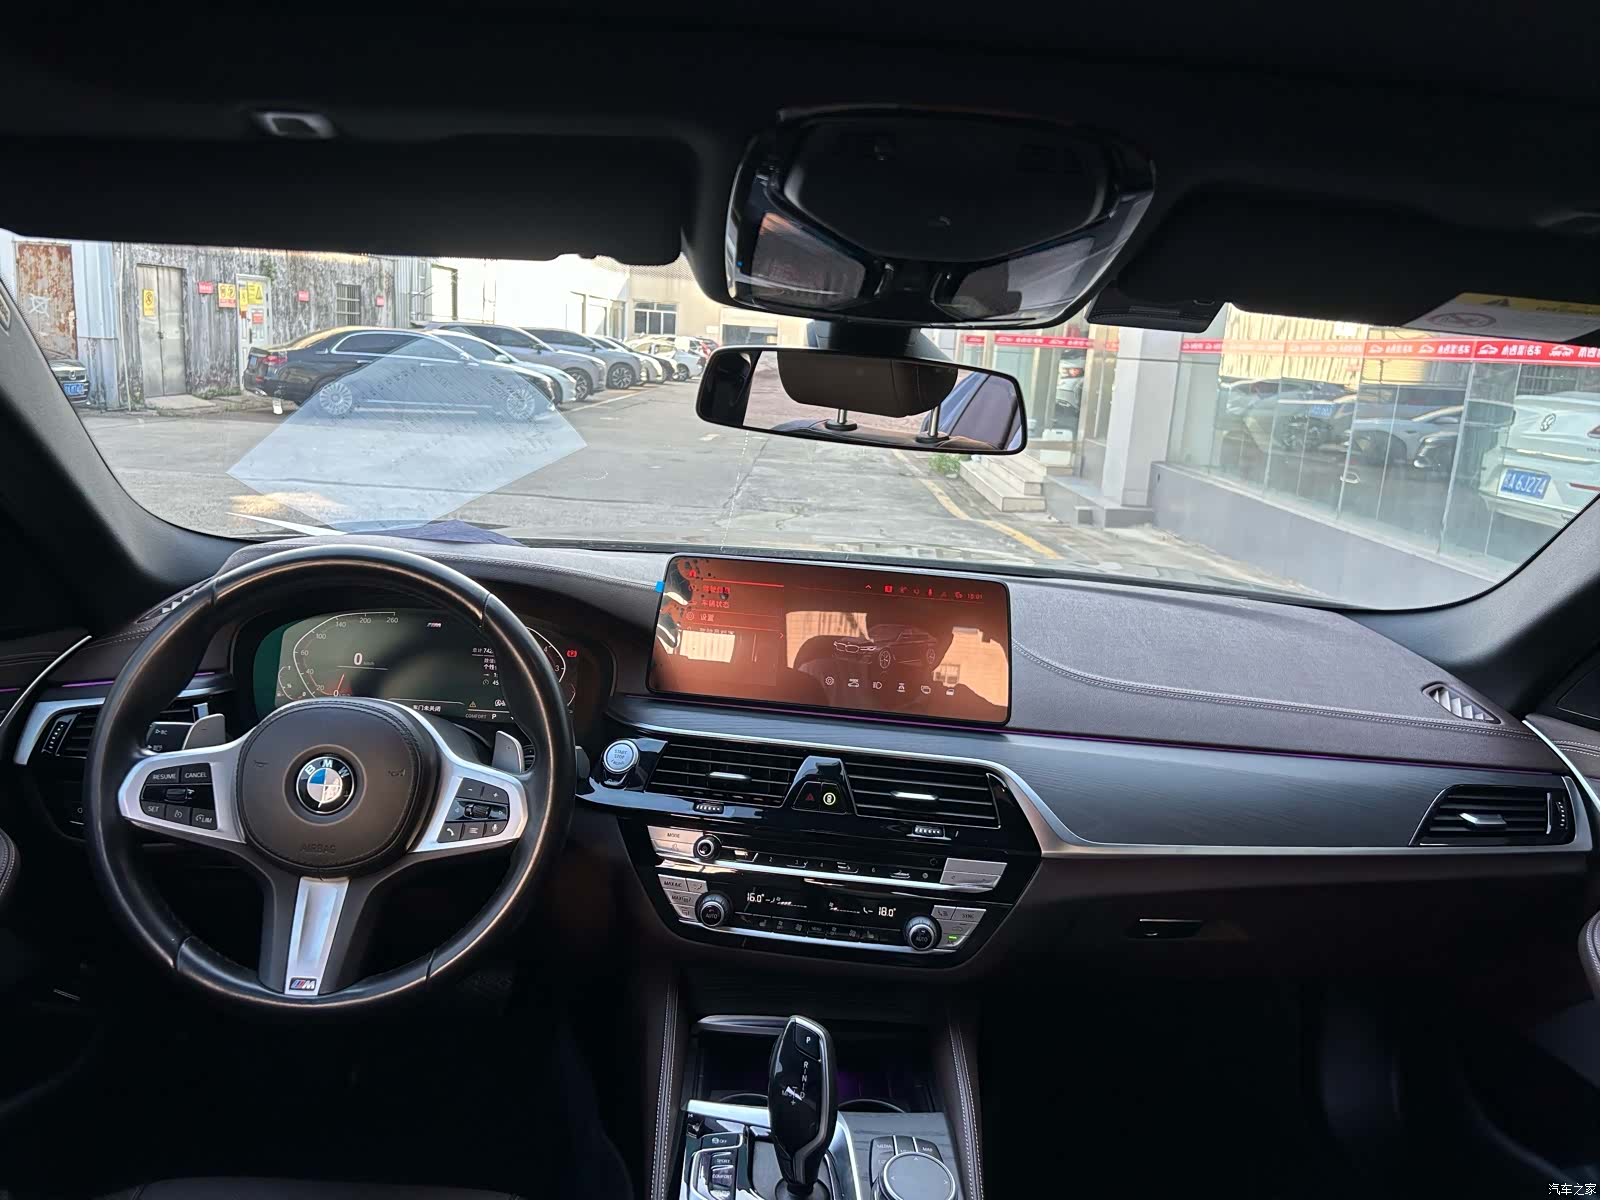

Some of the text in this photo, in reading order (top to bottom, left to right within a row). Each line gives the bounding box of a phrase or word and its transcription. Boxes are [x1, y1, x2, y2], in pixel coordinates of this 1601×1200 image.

[386, 616, 399, 624] 260
[700, 613, 715, 622] 设置
[300, 649, 309, 657] 60
[353, 652, 363, 666] 0
[554, 664, 560, 672] 3
[316, 684, 325, 692] 20
[333, 689, 339, 697] 0
[304, 759, 350, 779] BMW
[806, 1036, 811, 1044] P
